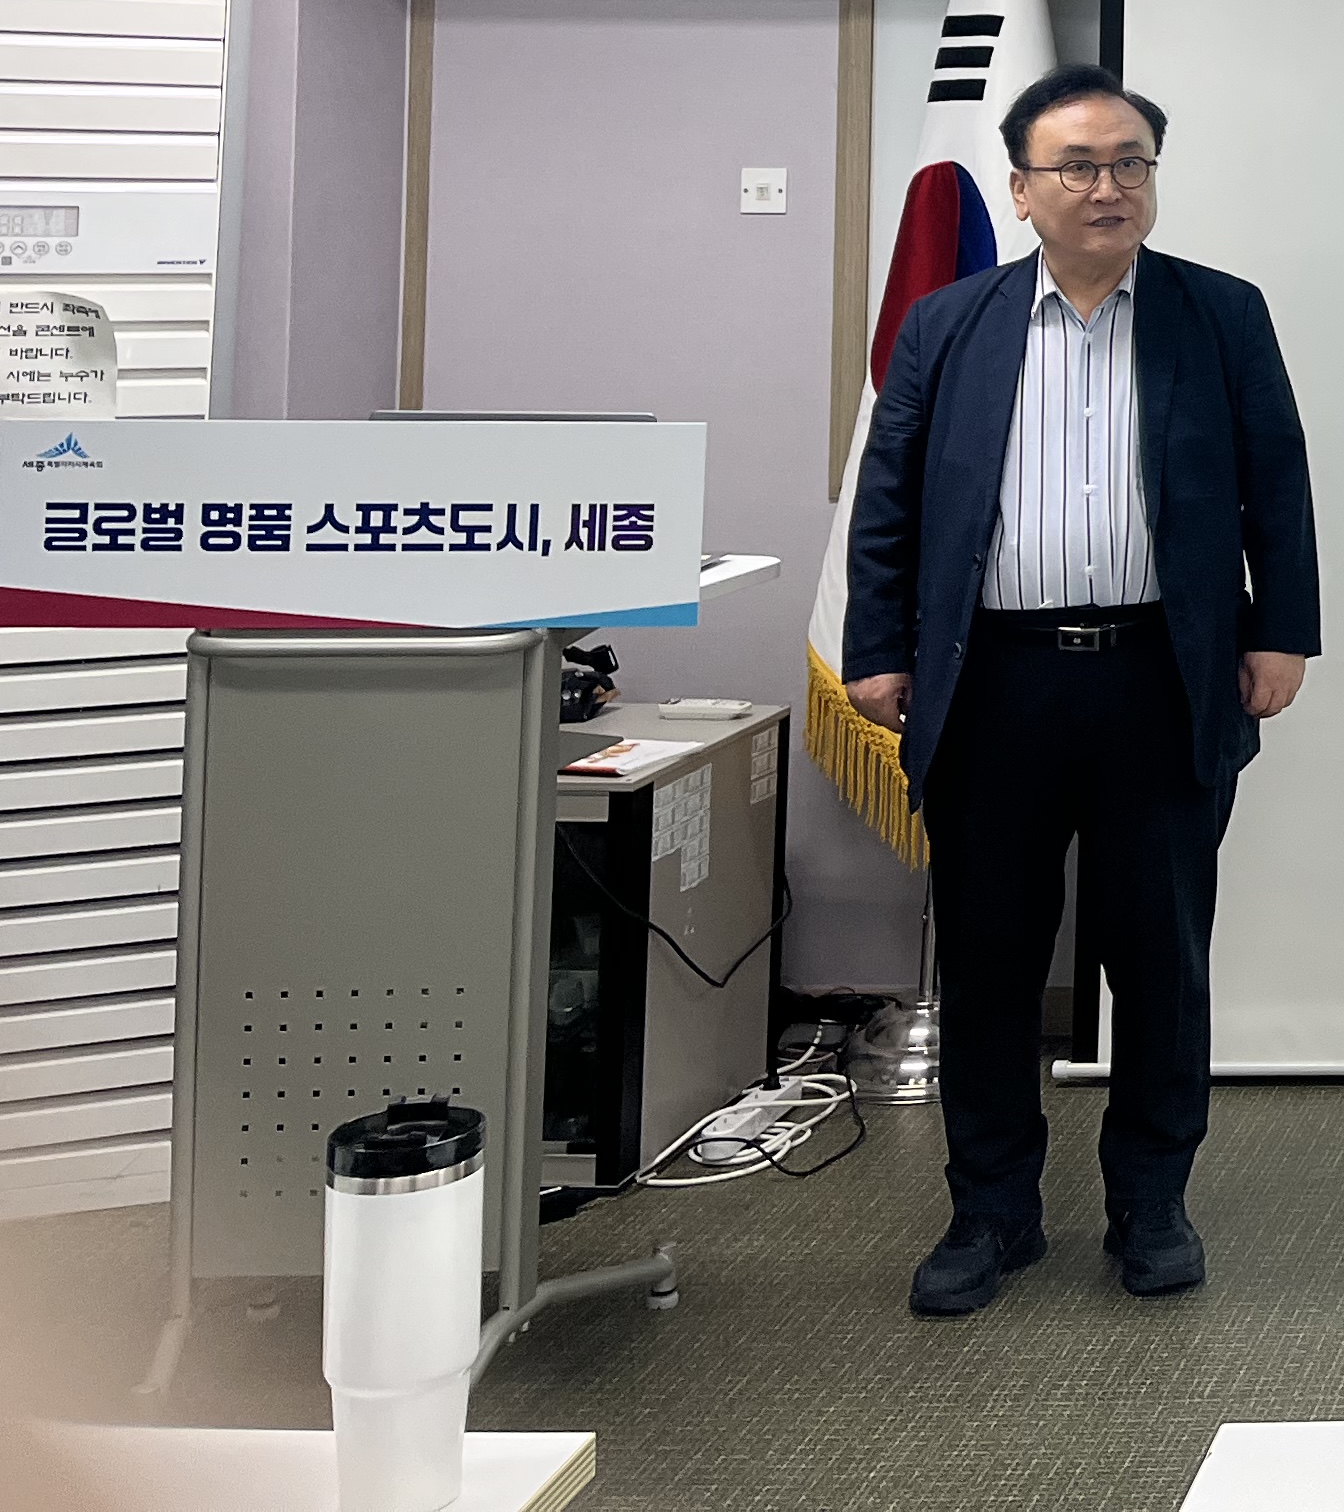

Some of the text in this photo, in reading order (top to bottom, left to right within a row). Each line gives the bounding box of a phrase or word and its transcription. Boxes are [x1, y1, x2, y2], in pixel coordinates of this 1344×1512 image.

[9, 301, 54, 314] 반드시
[6, 370, 104, 382] 시에는 누수가
[43, 501, 656, 557] 글로벌 명품 스포츠도시, 세종
